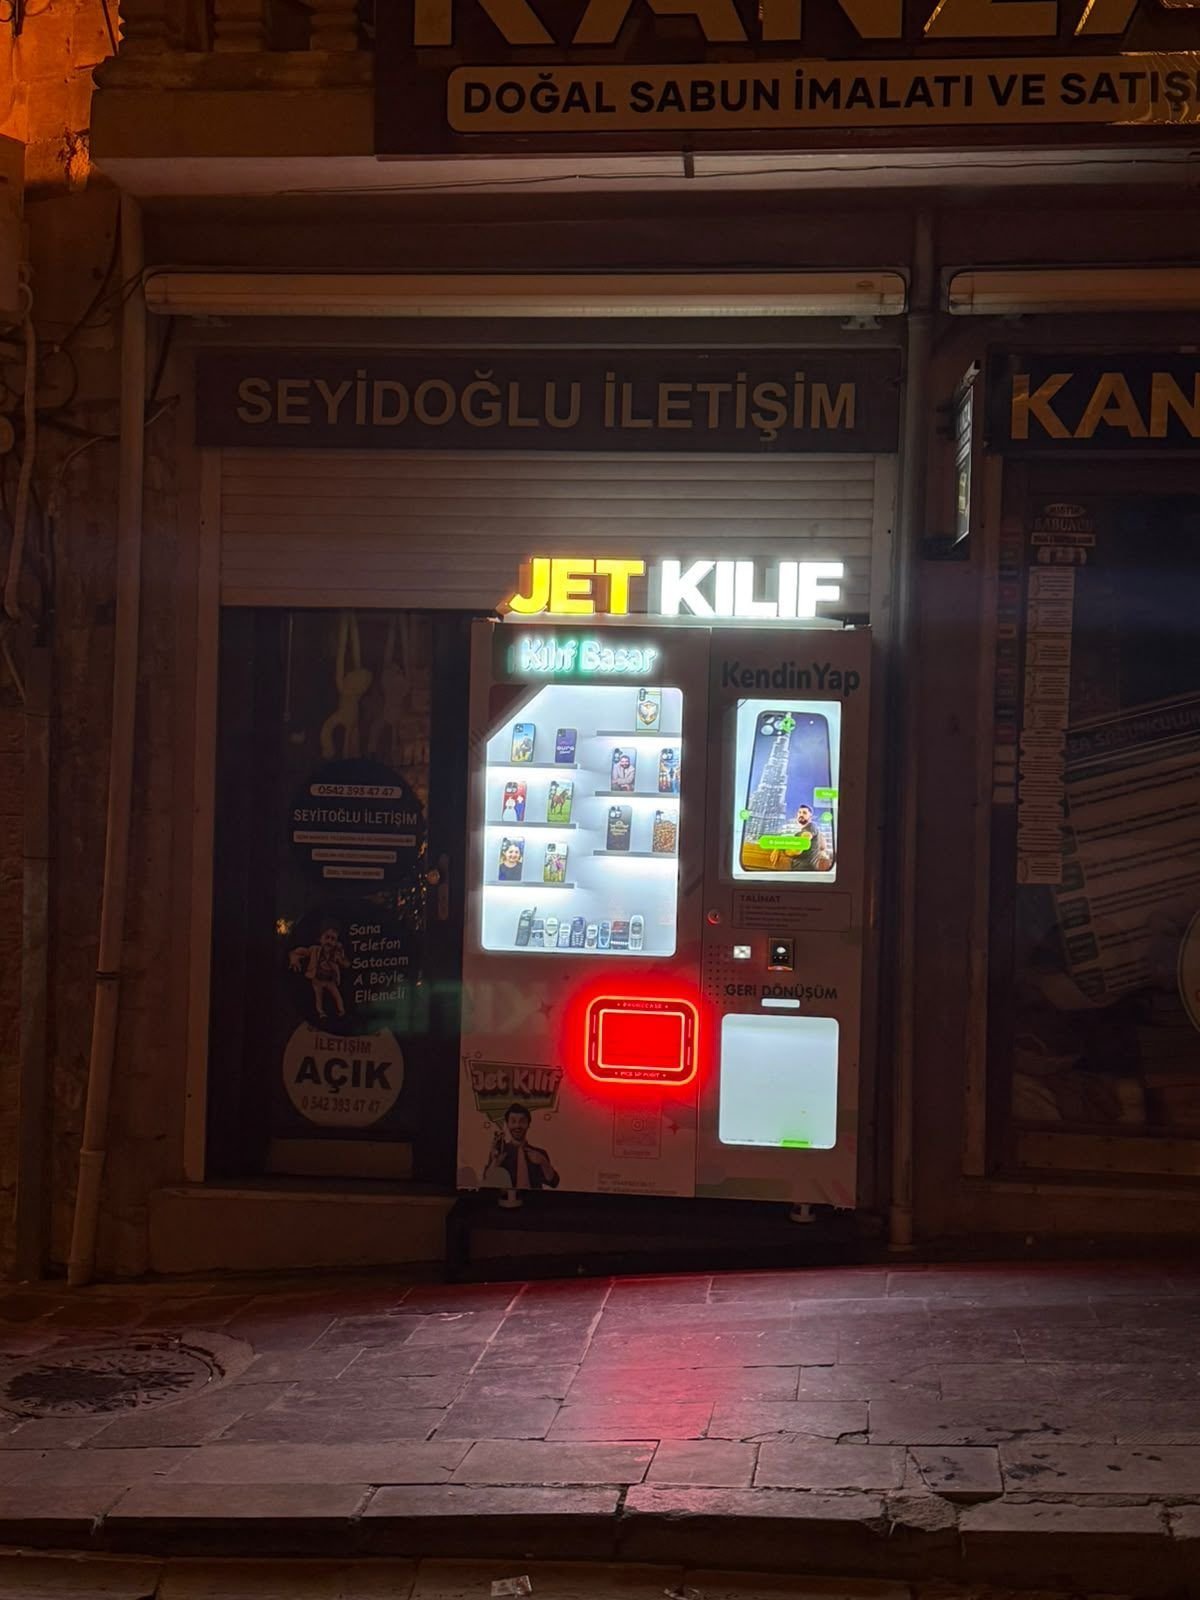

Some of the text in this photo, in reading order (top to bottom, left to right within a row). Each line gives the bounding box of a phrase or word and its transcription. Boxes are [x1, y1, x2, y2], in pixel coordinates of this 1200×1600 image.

[463, 72, 617, 114] DOĞAL
[629, 78, 781, 113] SABUN
[794, 68, 973, 110] İMALATI
[987, 73, 1046, 107] VE
[236, 369, 857, 442] SEYİDOĞLU İLETİŞİM
[508, 557, 844, 618] JET KILIF
[580, 640, 658, 673] Basar
[721, 660, 861, 697] KendinYap
[318, 786, 394, 796] 0542 393 47 47
[293, 808, 418, 828] SEYİTOĞLU İLETİŞİM
[349, 923, 382, 936] Sana
[351, 937, 401, 952] Telefon
[351, 956, 409, 969] Satacam
[353, 970, 406, 987] A Böyle
[725, 982, 838, 1002] GERİ DÖNÜŞÜM
[314, 1035, 372, 1055] İLETİŞİM
[294, 1055, 393, 1094] AÇIK
[472, 1069, 507, 1092] Jet
[310, 1096, 330, 1111] 542
[331, 1097, 351, 1112] 393
[352, 1098, 366, 1113] 47
[367, 1099, 381, 1113] 47
